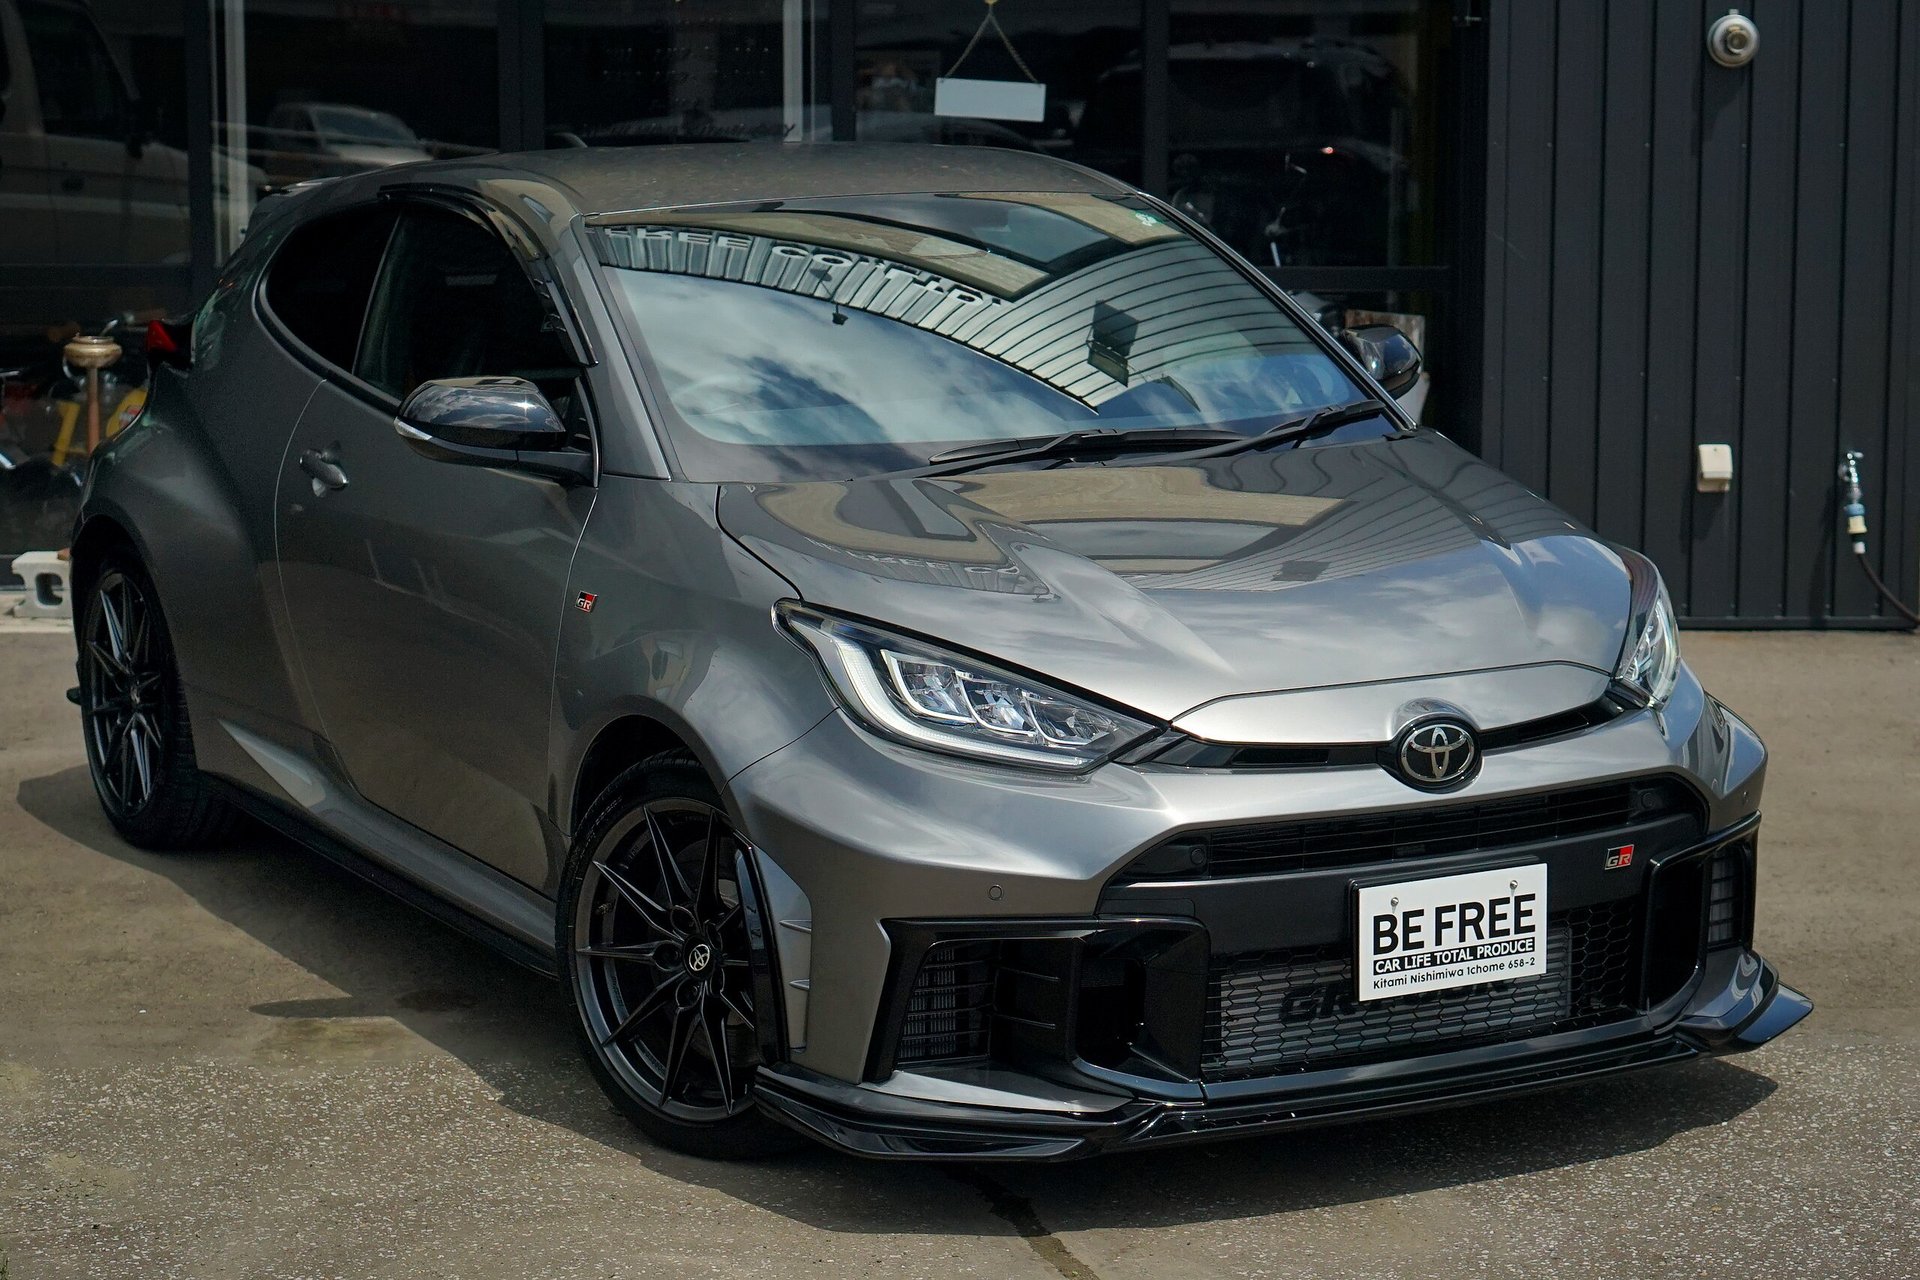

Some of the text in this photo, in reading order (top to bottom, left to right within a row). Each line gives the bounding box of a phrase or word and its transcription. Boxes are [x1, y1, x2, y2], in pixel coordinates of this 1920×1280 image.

[1607, 853, 1631, 867] GR
[1373, 893, 1536, 955] BE FREE
[1373, 974, 1407, 989] Kitami
[1411, 968, 1464, 984] Nishimiwa
[1508, 957, 1536, 969] 658-2
[1375, 939, 1534, 974] CAR LIFE TOTAL PRODUCE
